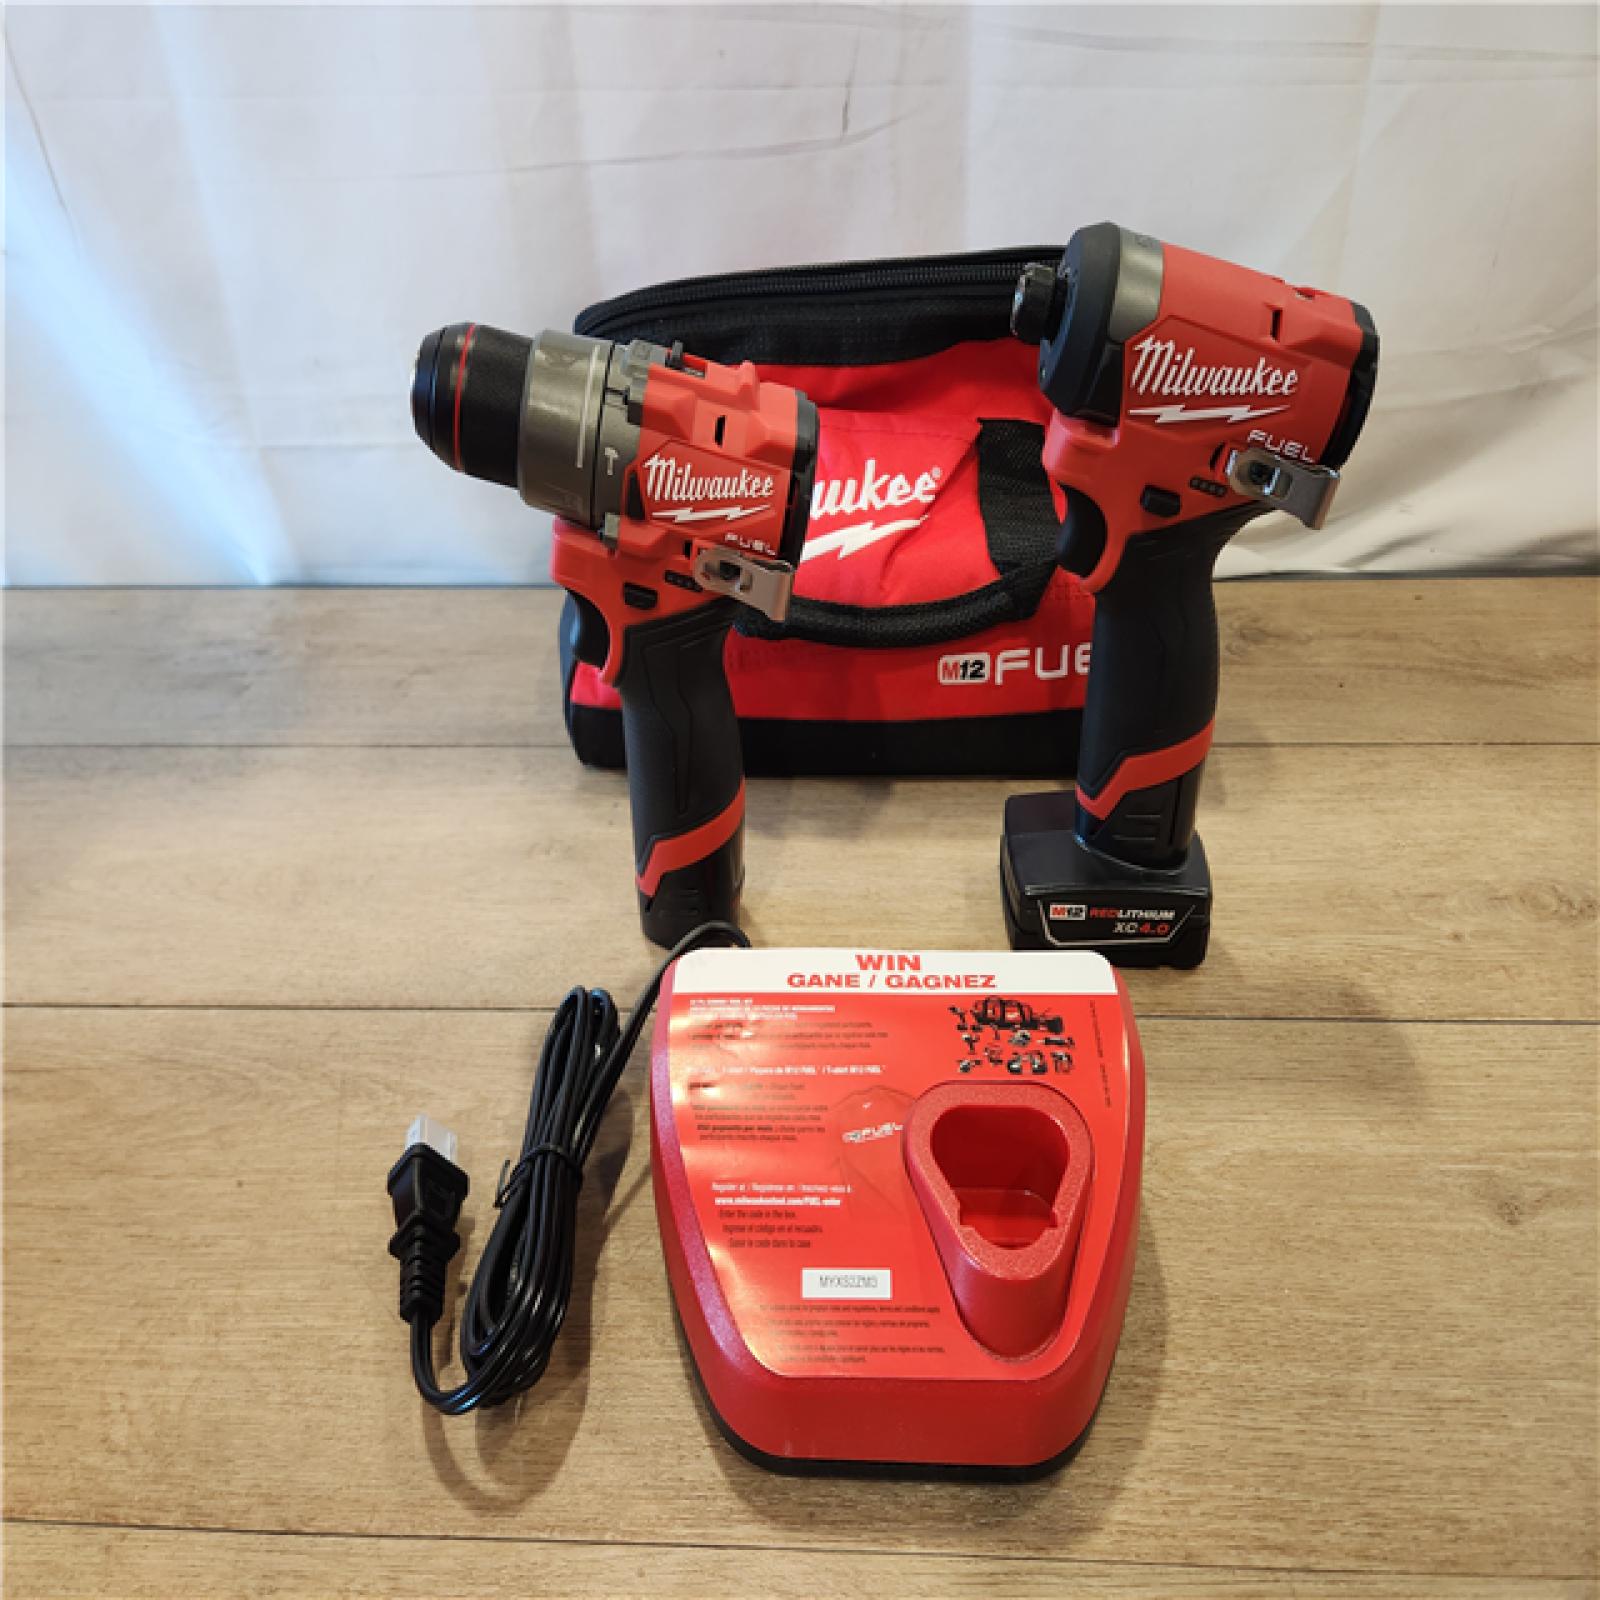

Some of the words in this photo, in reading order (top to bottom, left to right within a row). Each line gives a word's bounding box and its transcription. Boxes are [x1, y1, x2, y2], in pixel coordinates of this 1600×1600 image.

[1130, 335, 1298, 396] Milwaukee
[1247, 429, 1315, 463] FUEL
[642, 452, 775, 501] Milwaukee
[941, 658, 986, 682] M12
[995, 642, 1091, 686] FUE
[1051, 905, 1085, 918] M12
[855, 954, 922, 971] WIN
[787, 973, 860, 988] GANE
[867, 974, 876, 988] /
[884, 974, 997, 989] GAGNEZ
